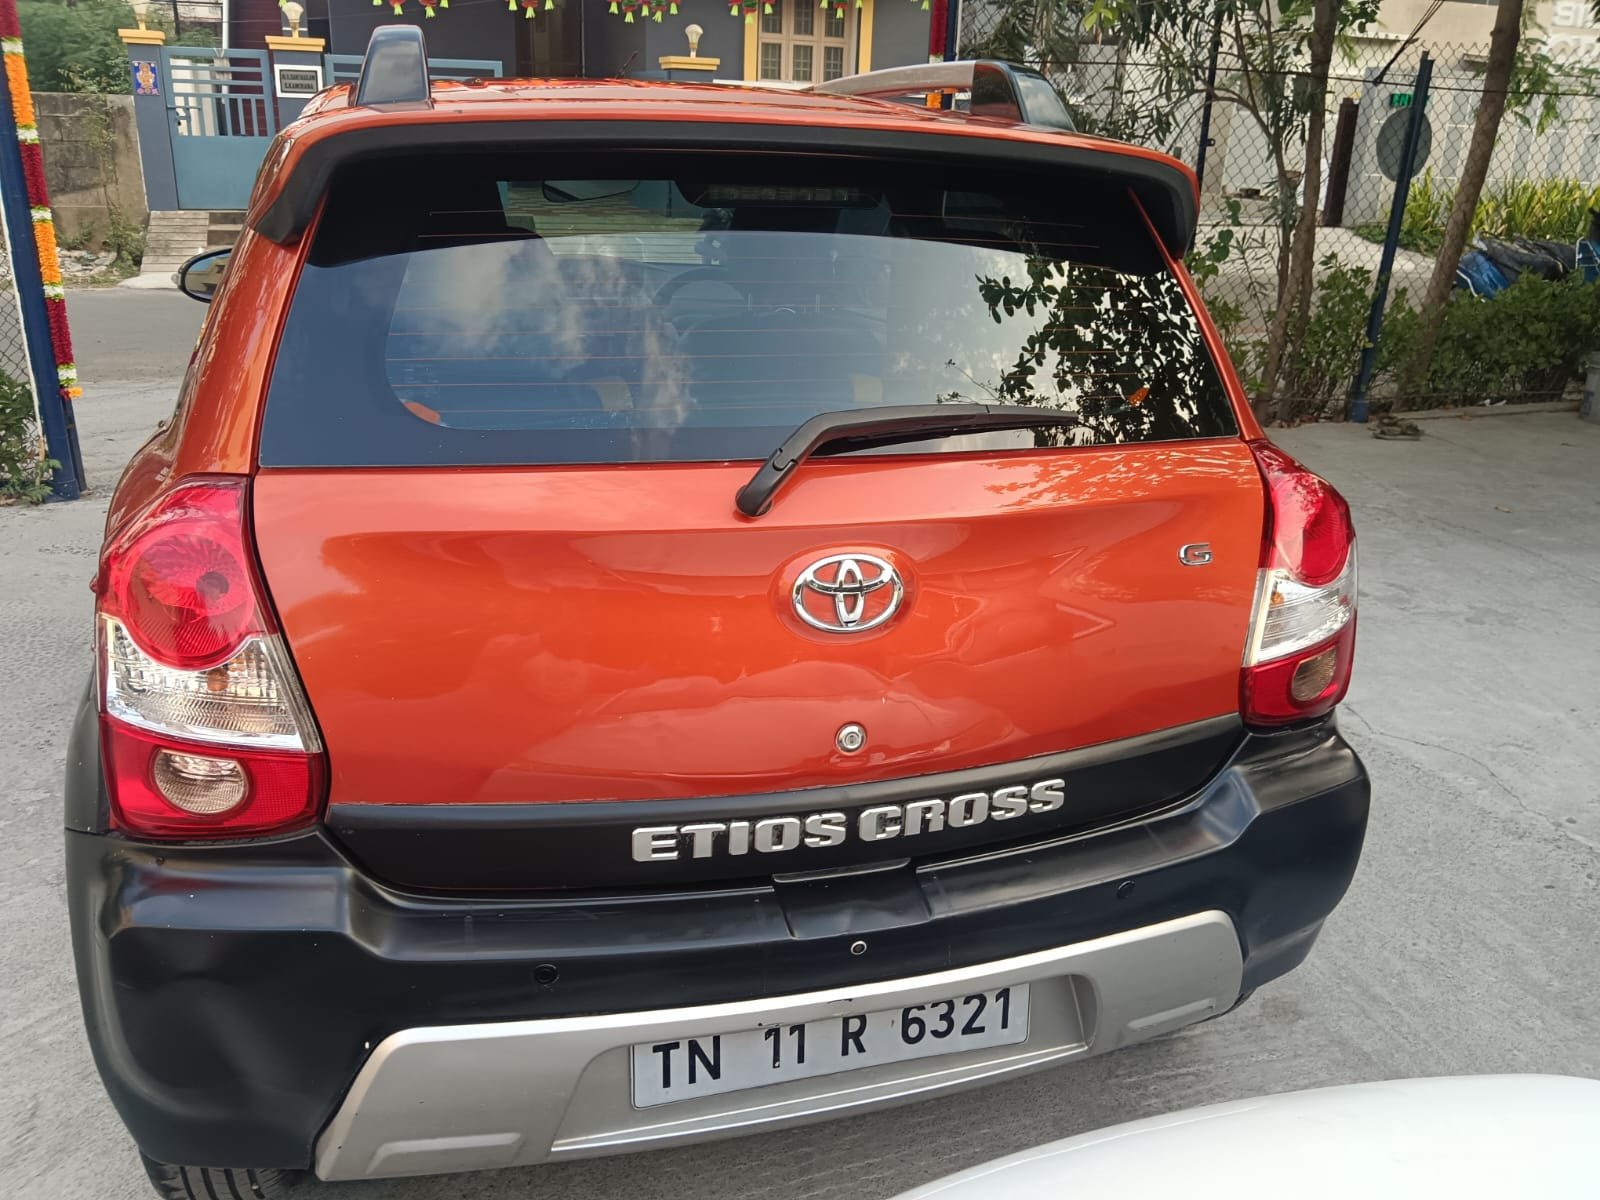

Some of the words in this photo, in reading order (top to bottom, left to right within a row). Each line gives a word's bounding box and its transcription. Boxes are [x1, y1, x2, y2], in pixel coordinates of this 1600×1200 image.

[1178, 543, 1212, 566] G
[632, 812, 847, 862] ETIOS
[858, 779, 1066, 842] CROSS
[652, 1035, 721, 1089] TN
[765, 1023, 806, 1069] 11
[841, 1014, 867, 1057] R
[901, 987, 1011, 1045] 6321
